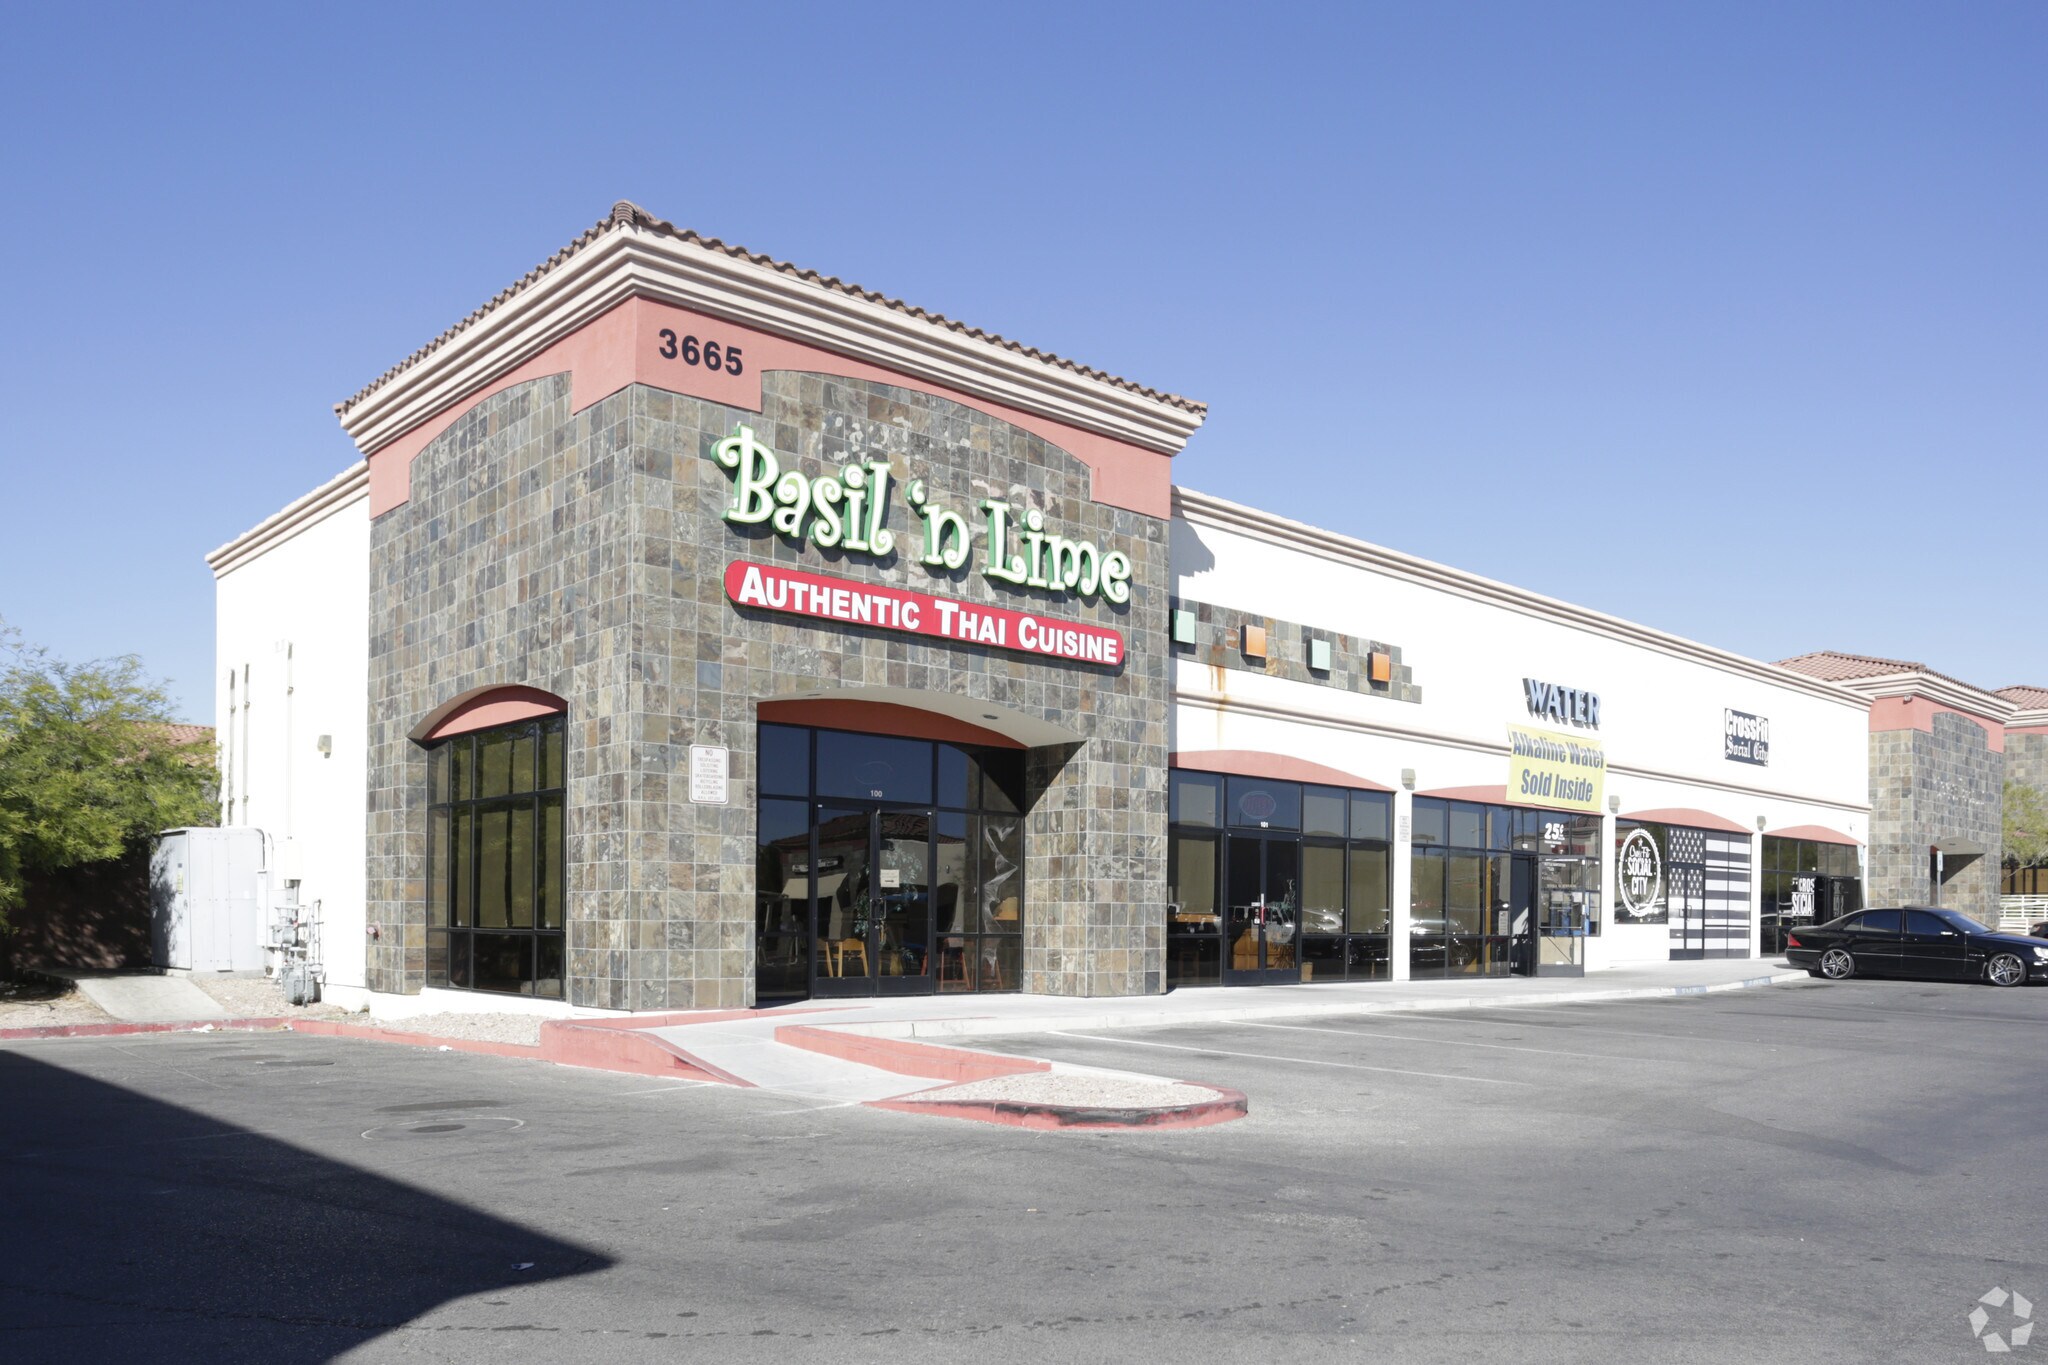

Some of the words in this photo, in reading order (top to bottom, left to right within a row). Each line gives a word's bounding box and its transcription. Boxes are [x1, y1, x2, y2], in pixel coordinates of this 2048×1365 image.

[659, 328, 743, 376] 3665
[711, 421, 894, 556] Basil
[980, 499, 1131, 603] Lime
[738, 566, 920, 630] AUTHENTIC
[934, 599, 1006, 645] THAI
[1018, 617, 1118, 663] CUISINE
[1523, 678, 1601, 727] WATER
[1725, 709, 1768, 743] CrossFit
[1511, 731, 1566, 763] Alkaline
[1566, 742, 1604, 769] Water
[1725, 735, 1751, 758] Social
[870, 789, 883, 798] 100
[1521, 768, 1552, 797] Sold
[1554, 774, 1593, 802] Inside
[1627, 857, 1653, 876] SOCIAL
[1632, 876, 1648, 895] CITY
